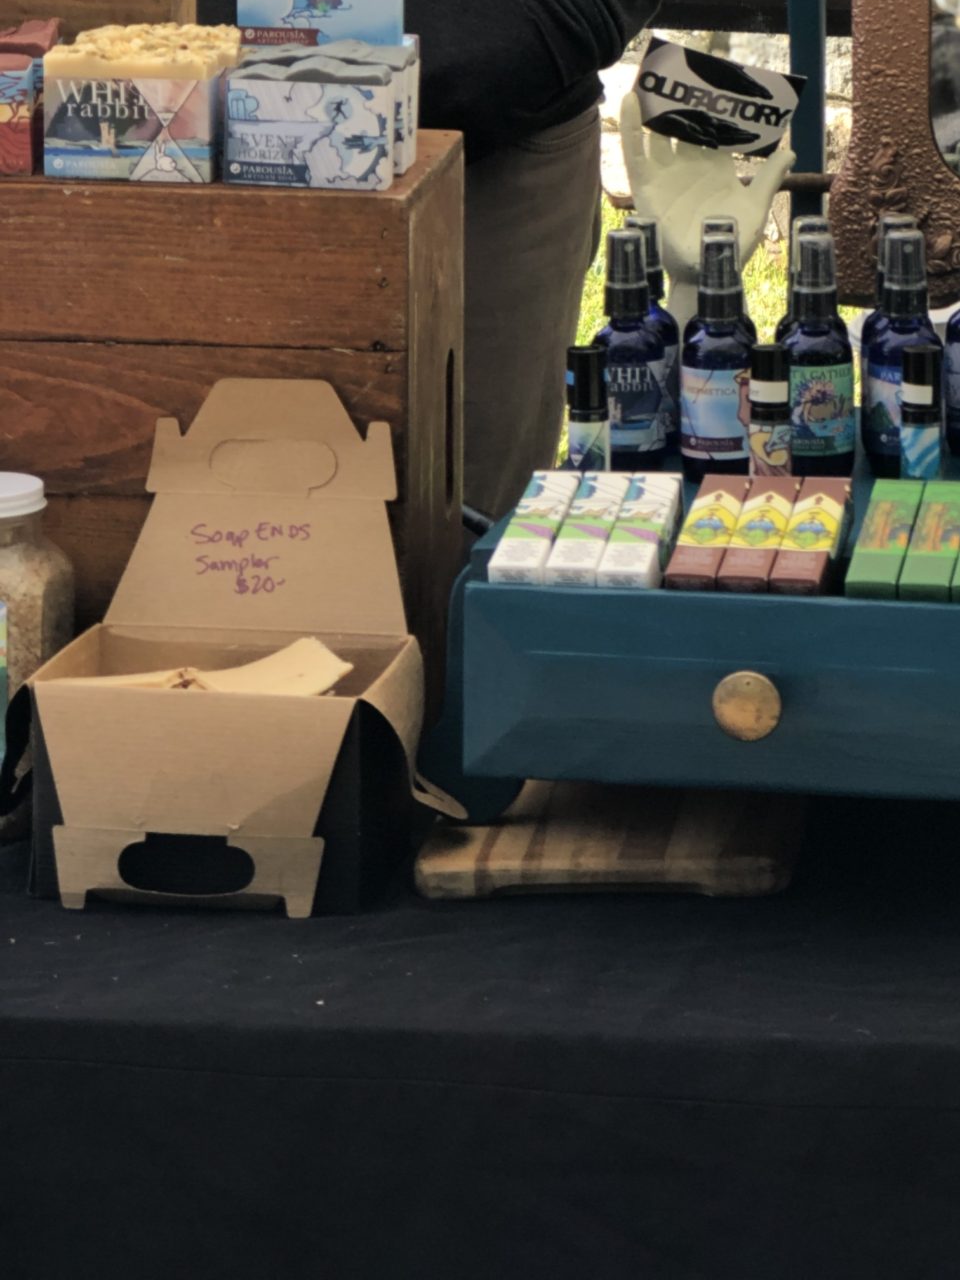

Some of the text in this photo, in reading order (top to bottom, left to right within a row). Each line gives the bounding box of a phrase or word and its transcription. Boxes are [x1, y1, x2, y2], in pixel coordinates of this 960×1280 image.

[66, 98, 151, 119] rabbit
[638, 71, 793, 128] OLDFACTORY
[190, 522, 313, 548] Soap ENDS
[195, 553, 281, 576] Sampler
